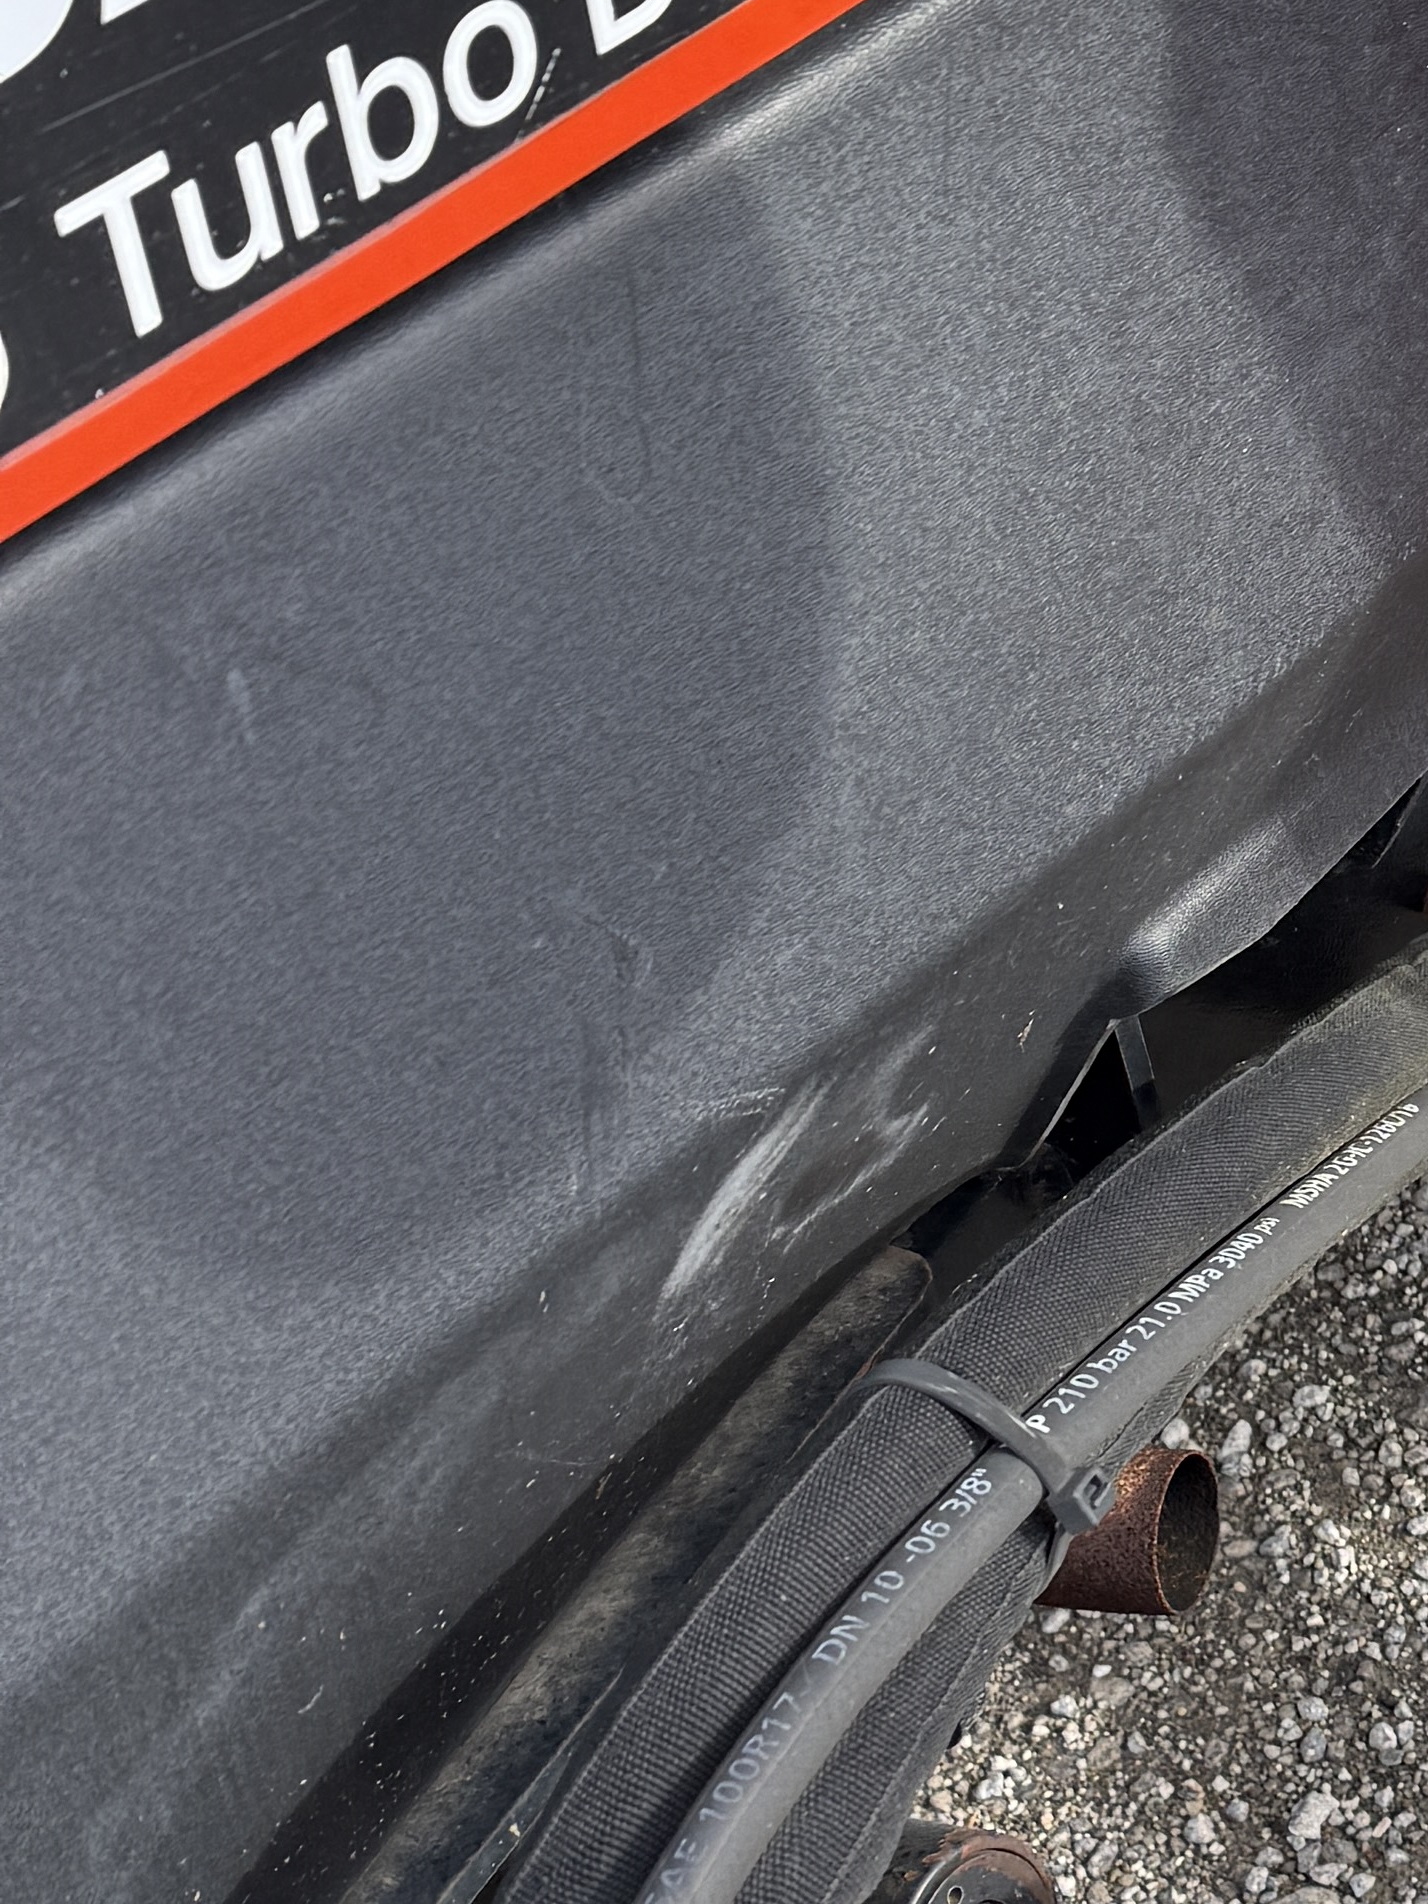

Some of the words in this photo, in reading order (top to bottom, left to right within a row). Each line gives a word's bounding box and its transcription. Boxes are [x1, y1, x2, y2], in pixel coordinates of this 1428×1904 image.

[811, 1614, 871, 1665] DN
[860, 1569, 905, 1604] 10
[904, 1519, 951, 1564] -06
[1042, 1373, 1100, 1415] 210
[1086, 1338, 1138, 1374] bar
[1125, 1300, 1182, 1341] 21.0
[1168, 1266, 1225, 1303] MPa
[1208, 1231, 1264, 1270] 3040
[1253, 1216, 1281, 1236] psi
[1279, 1171, 1340, 1209] MSHA
